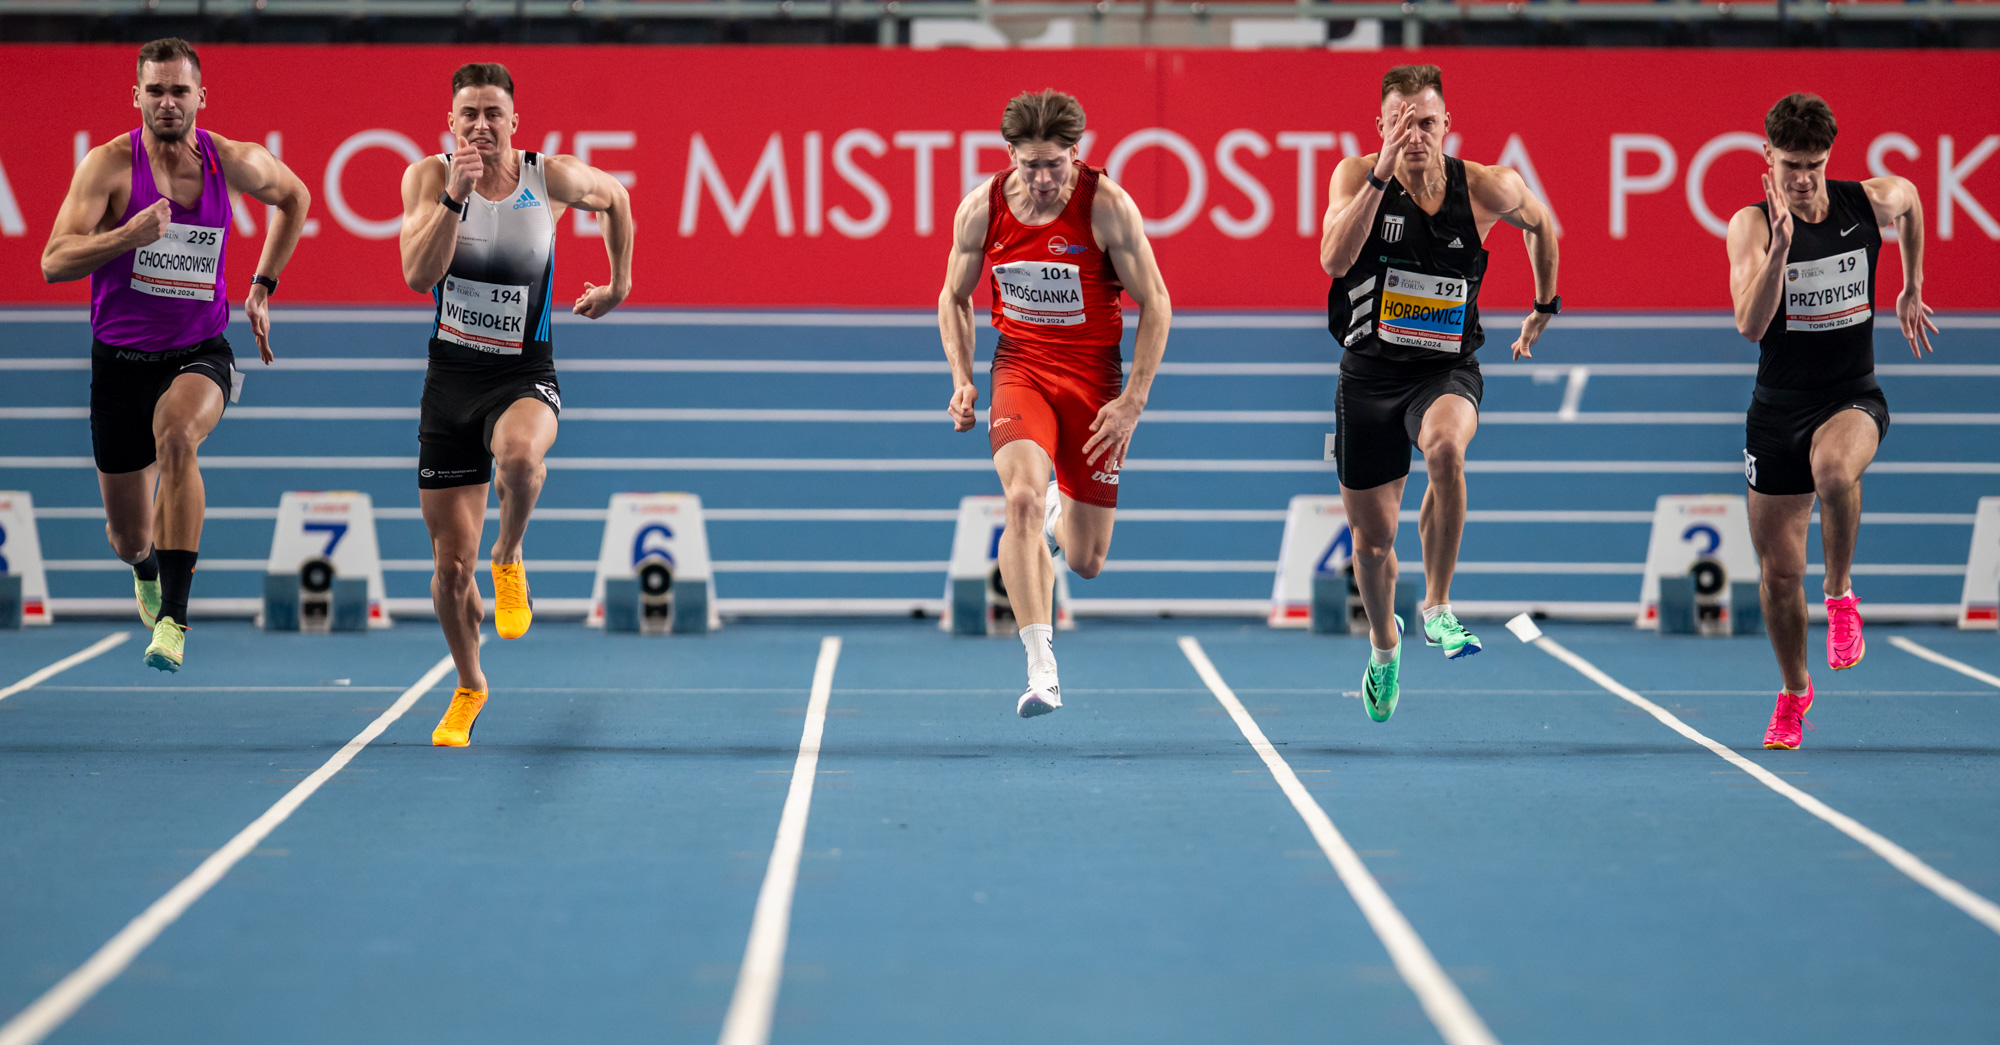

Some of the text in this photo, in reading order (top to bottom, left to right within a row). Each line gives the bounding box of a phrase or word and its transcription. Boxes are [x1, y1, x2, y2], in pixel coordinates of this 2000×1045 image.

[513, 200, 540, 210] adidas
[186, 230, 216, 246] 295
[138, 250, 216, 274] CHOCHOROWSKI
[1838, 257, 1856, 273] 19
[1041, 268, 1071, 280] 101
[151, 286, 176, 294] TORUŃ
[1002, 282, 1079, 303] TROŚCIANKA
[1400, 282, 1424, 291] TORUŃ
[1435, 282, 1463, 298] 191
[1790, 280, 1865, 306] PRZYBYLSKI
[490, 289, 521, 304] 194
[446, 301, 522, 332] WIESIOŁEK
[1021, 315, 1045, 323] TORUŃ
[1384, 300, 1463, 325] HORBOWICZ
[1808, 317, 1852, 329] TORUŃ 2024
[1396, 337, 1422, 345] TORUŃ
[116, 350, 160, 362] NIKE
[482, 346, 500, 354] 2024
[303, 522, 348, 561] 7
[632, 522, 676, 569] 6
